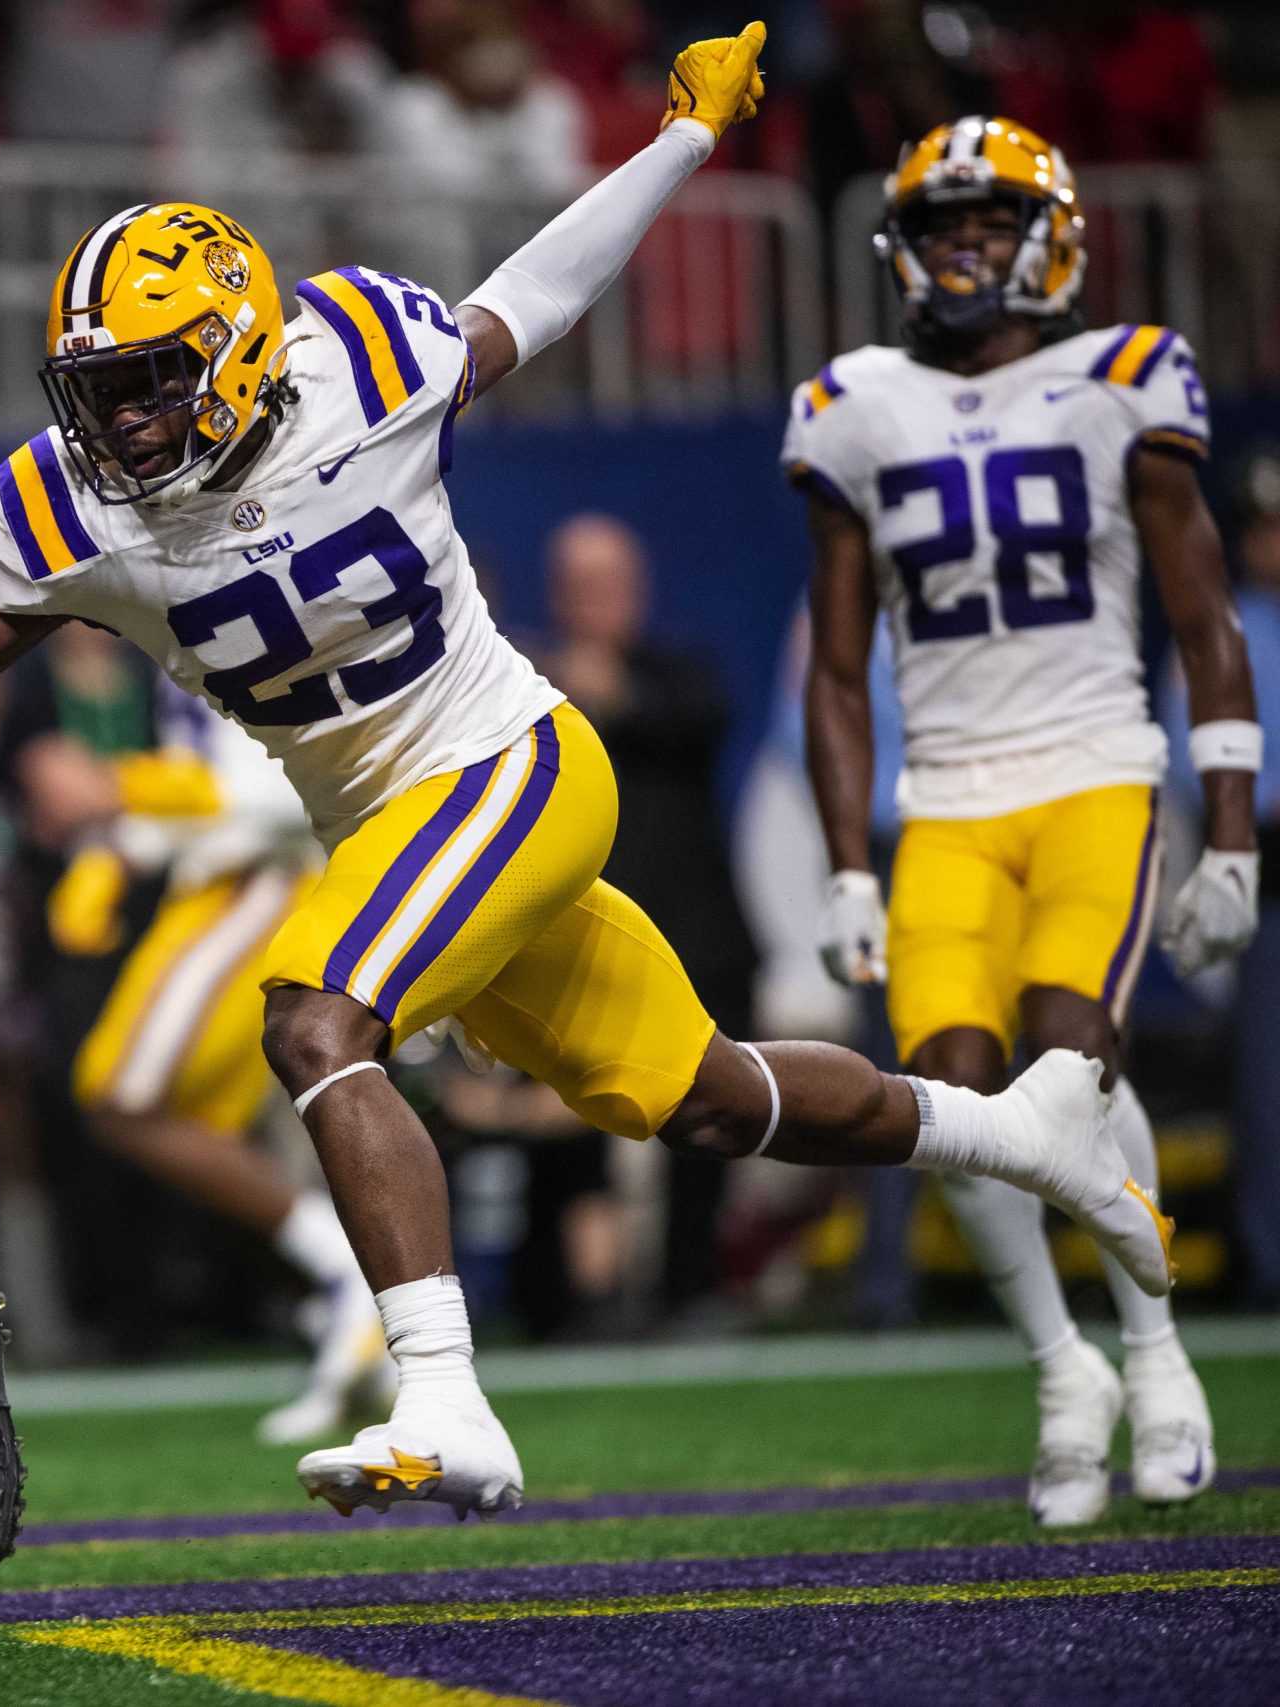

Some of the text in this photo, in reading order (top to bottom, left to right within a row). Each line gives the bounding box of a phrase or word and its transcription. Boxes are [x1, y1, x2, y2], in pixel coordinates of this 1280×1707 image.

[137, 211, 253, 271] LSU
[64, 335, 94, 352] LSU
[232, 501, 265, 531] SEC
[241, 531, 295, 565] LSU
[877, 443, 1096, 644] 28
[167, 505, 447, 727] 23
